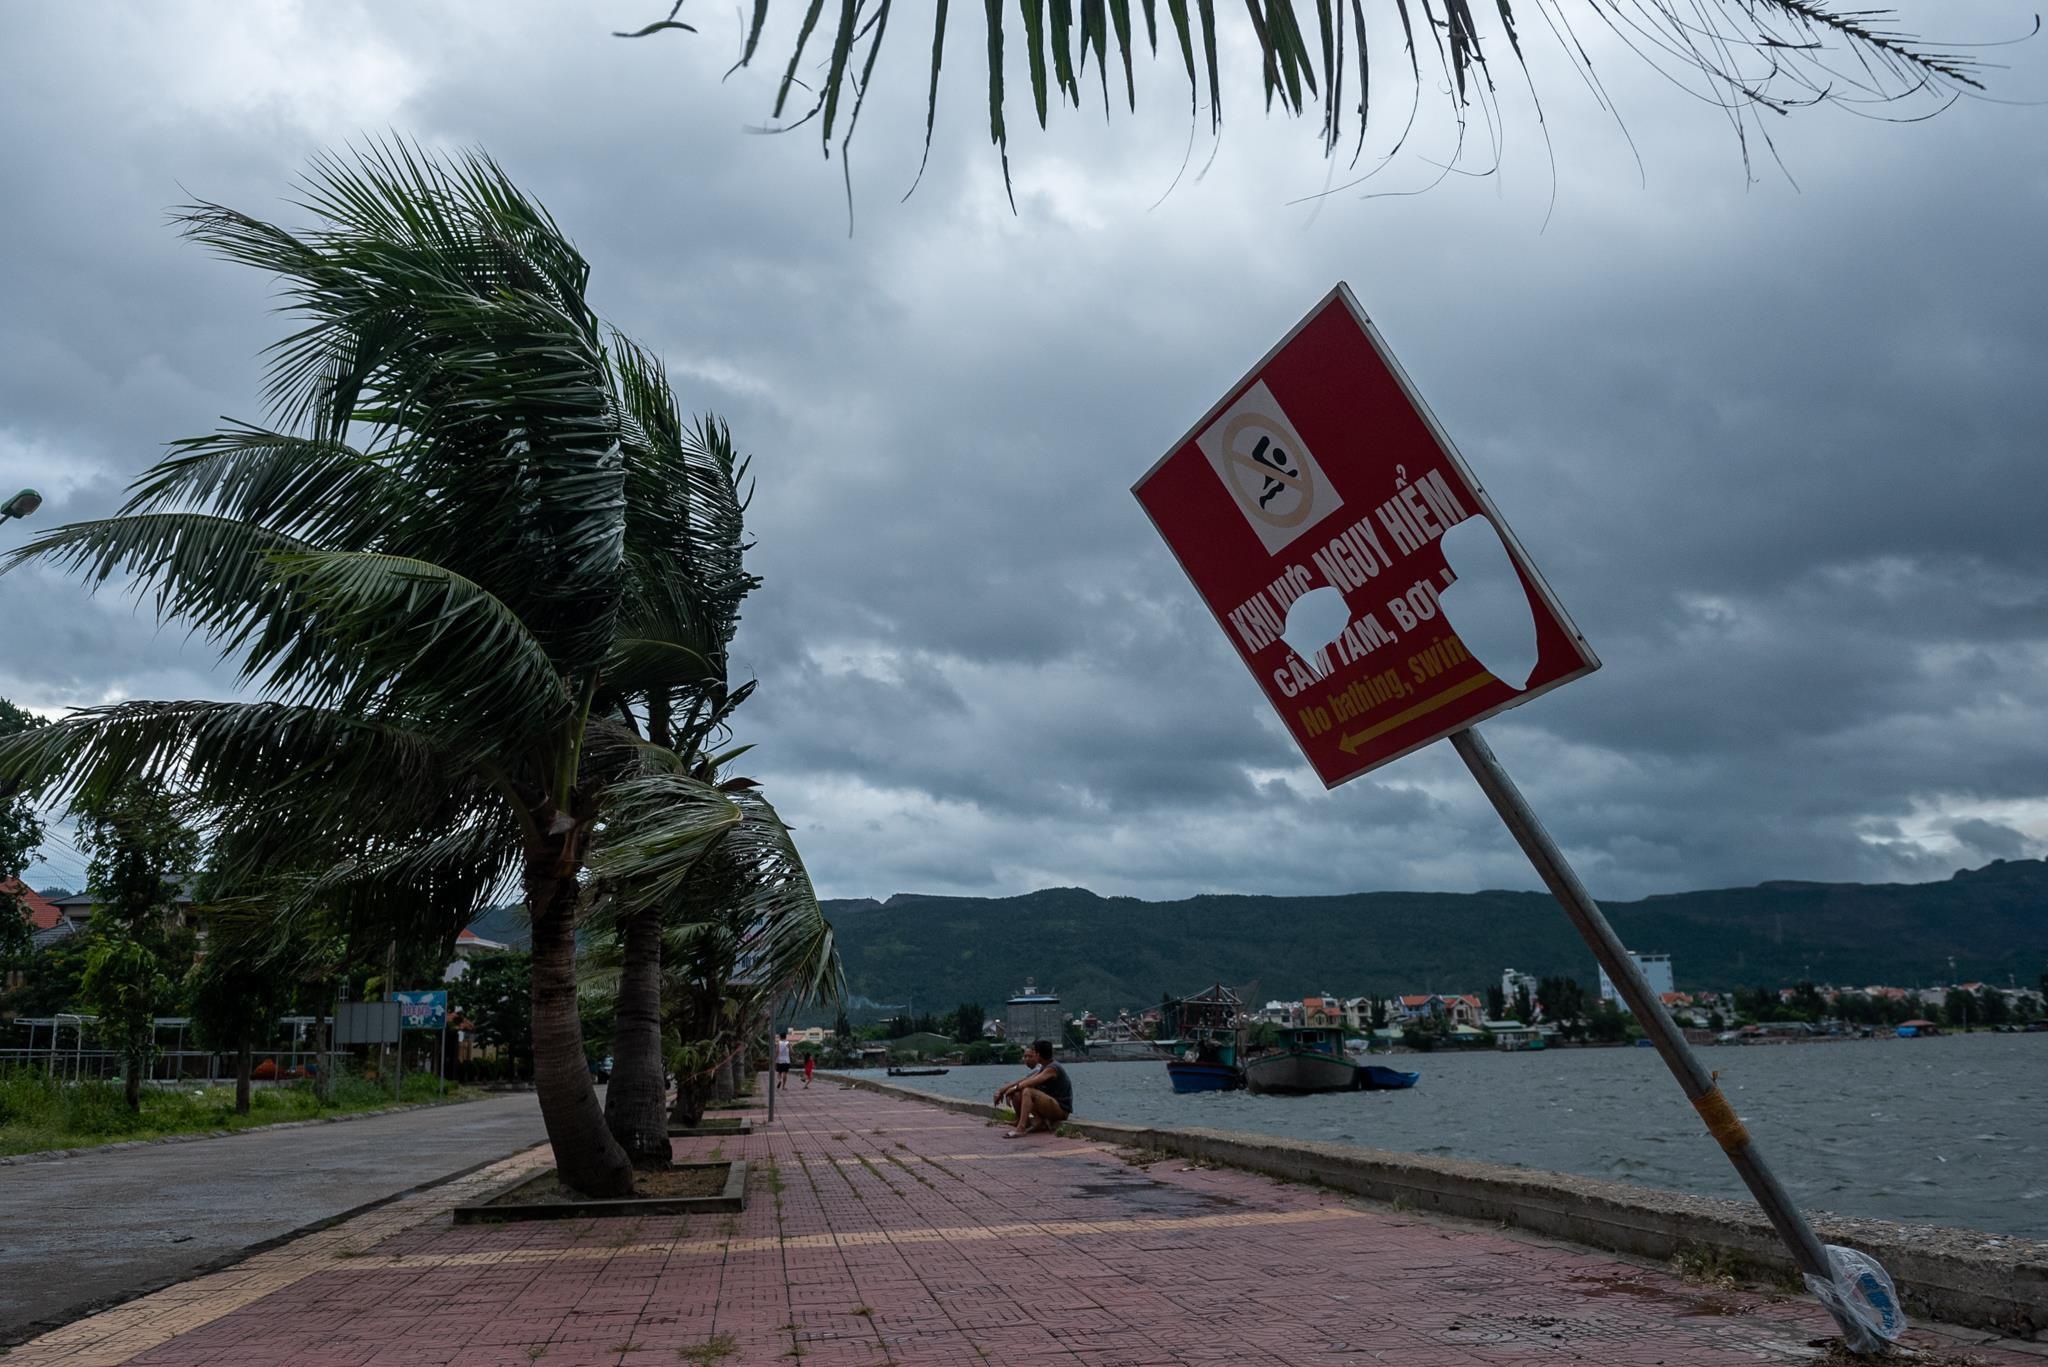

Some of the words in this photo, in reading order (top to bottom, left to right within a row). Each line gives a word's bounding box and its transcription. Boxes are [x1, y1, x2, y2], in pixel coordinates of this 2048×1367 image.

[1228, 592, 1285, 654] KHU
[1311, 517, 1394, 597] NGUY
[1375, 464, 1468, 556] HIỂM
[1298, 706, 1331, 738] No
[1327, 667, 1414, 727] bathing,
